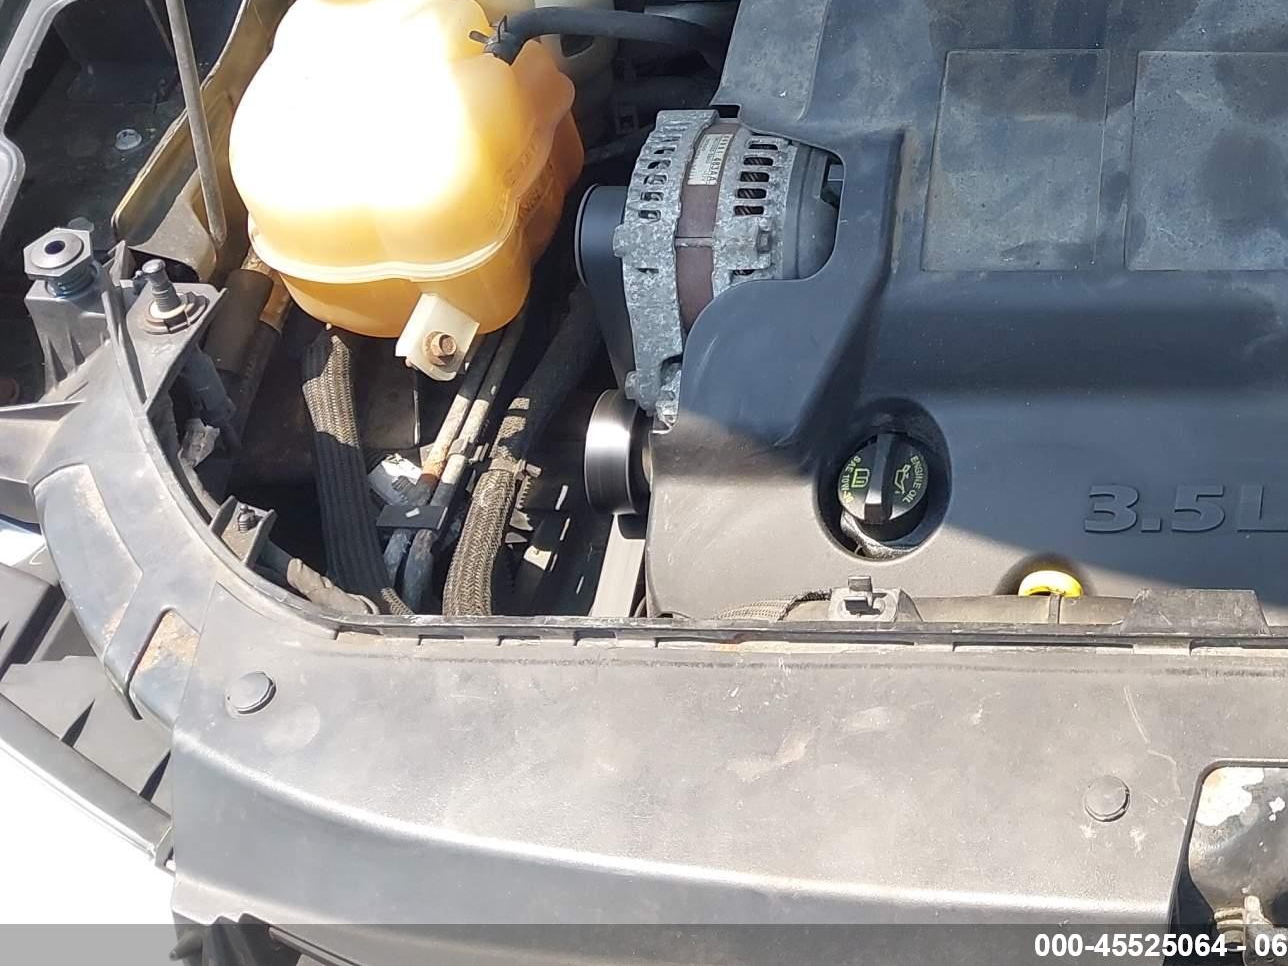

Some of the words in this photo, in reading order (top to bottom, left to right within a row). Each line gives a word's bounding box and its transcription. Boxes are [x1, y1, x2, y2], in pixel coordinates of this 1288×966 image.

[845, 455, 861, 473] SAE
[910, 455, 924, 490] ENGINE
[902, 490, 917, 504] OIL
